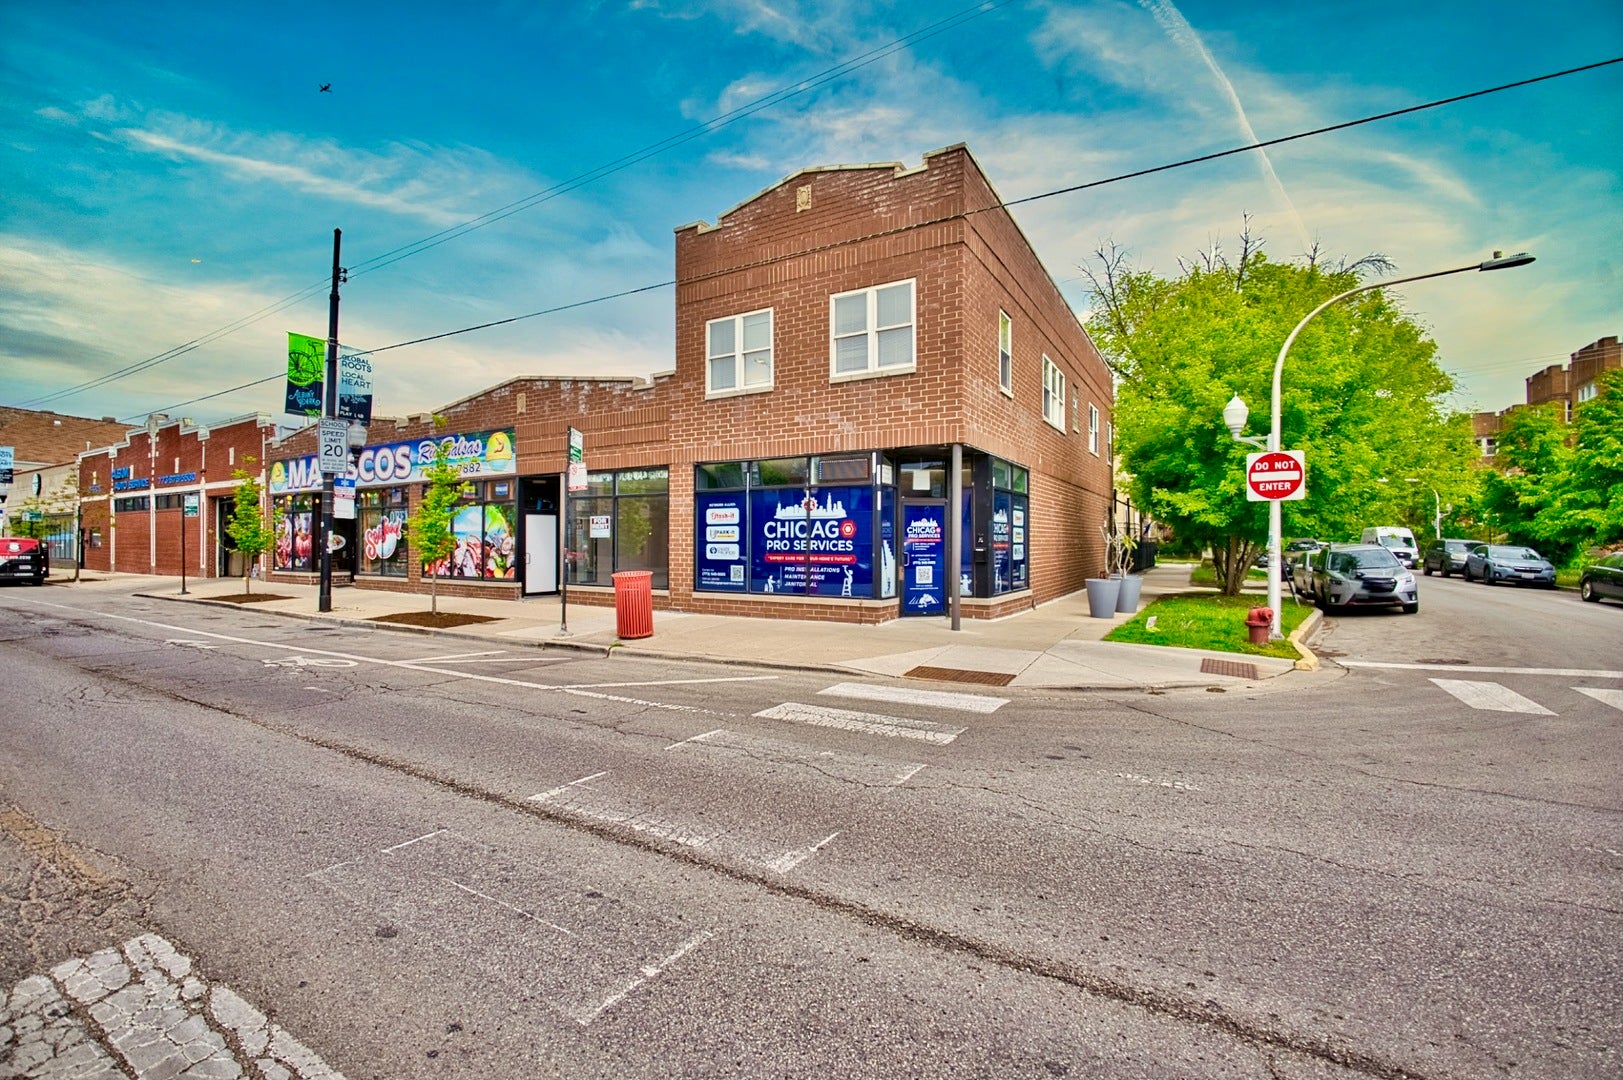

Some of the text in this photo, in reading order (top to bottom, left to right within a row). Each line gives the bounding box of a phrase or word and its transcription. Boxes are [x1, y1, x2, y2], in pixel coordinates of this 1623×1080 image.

[342, 354, 370, 365] GLOBAL
[342, 360, 372, 373] ROOTS
[342, 371, 365, 380] LOCAL
[342, 377, 371, 389] HEART
[321, 421, 346, 429] SCHOOL
[322, 430, 345, 438] SPEED
[324, 444, 343, 457] 20
[288, 445, 412, 489] MASCOS
[1255, 460, 1295, 471] DO NOT
[1259, 482, 1291, 491] ENTER
[766, 540, 854, 551] PRO SERVICES
